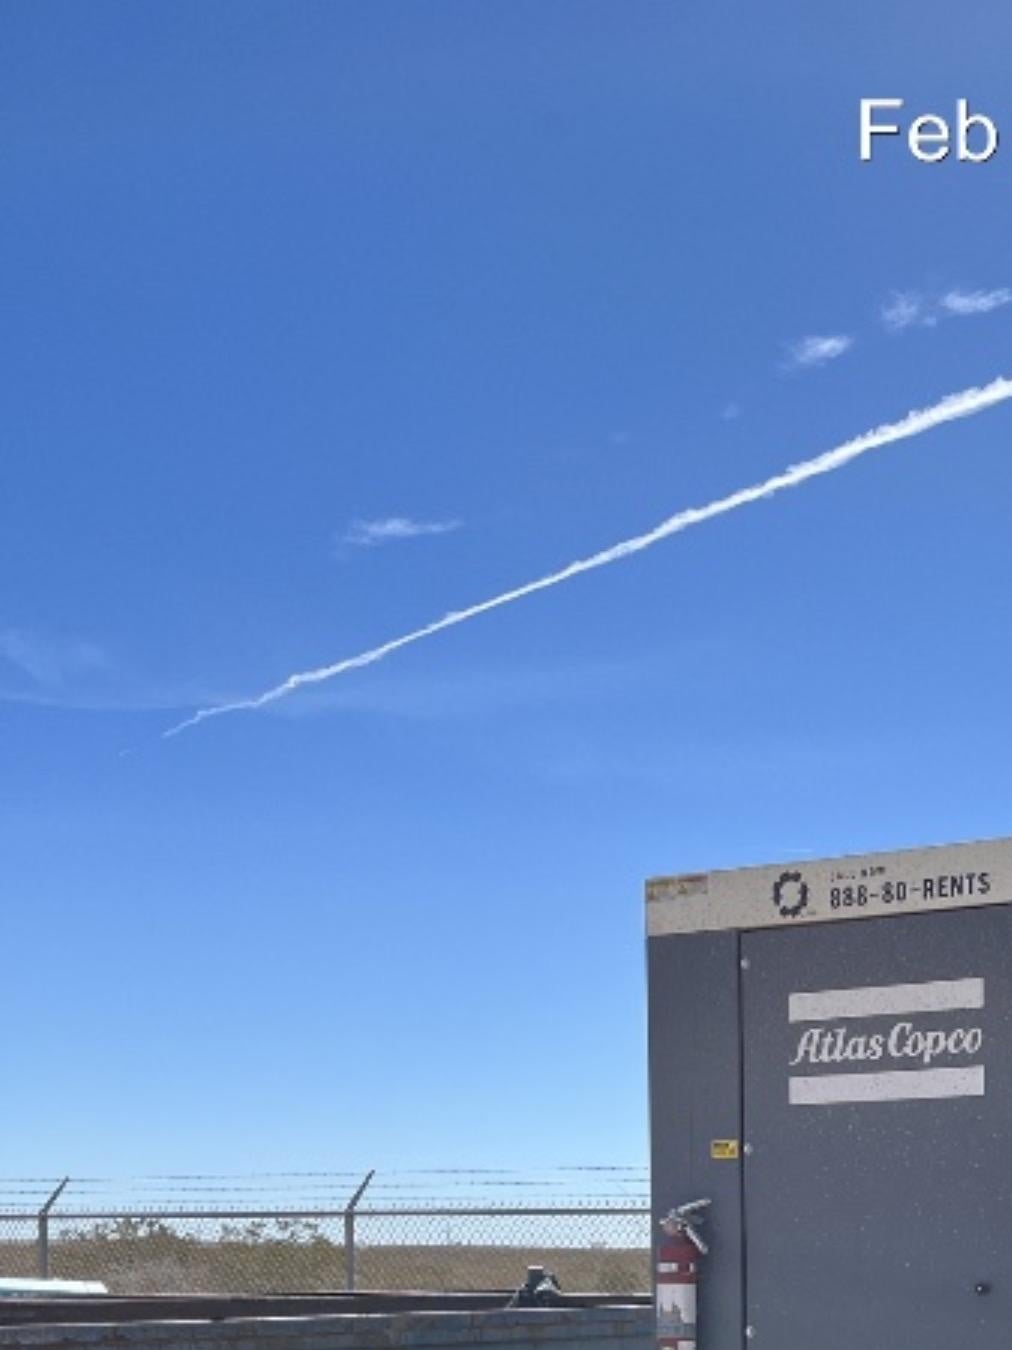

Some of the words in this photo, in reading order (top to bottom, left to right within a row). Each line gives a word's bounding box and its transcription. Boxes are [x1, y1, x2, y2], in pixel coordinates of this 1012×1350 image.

[829, 872, 992, 910] 888-80-RENTS
[788, 1026, 883, 1066] Atlas
[887, 1021, 983, 1064] Copco
